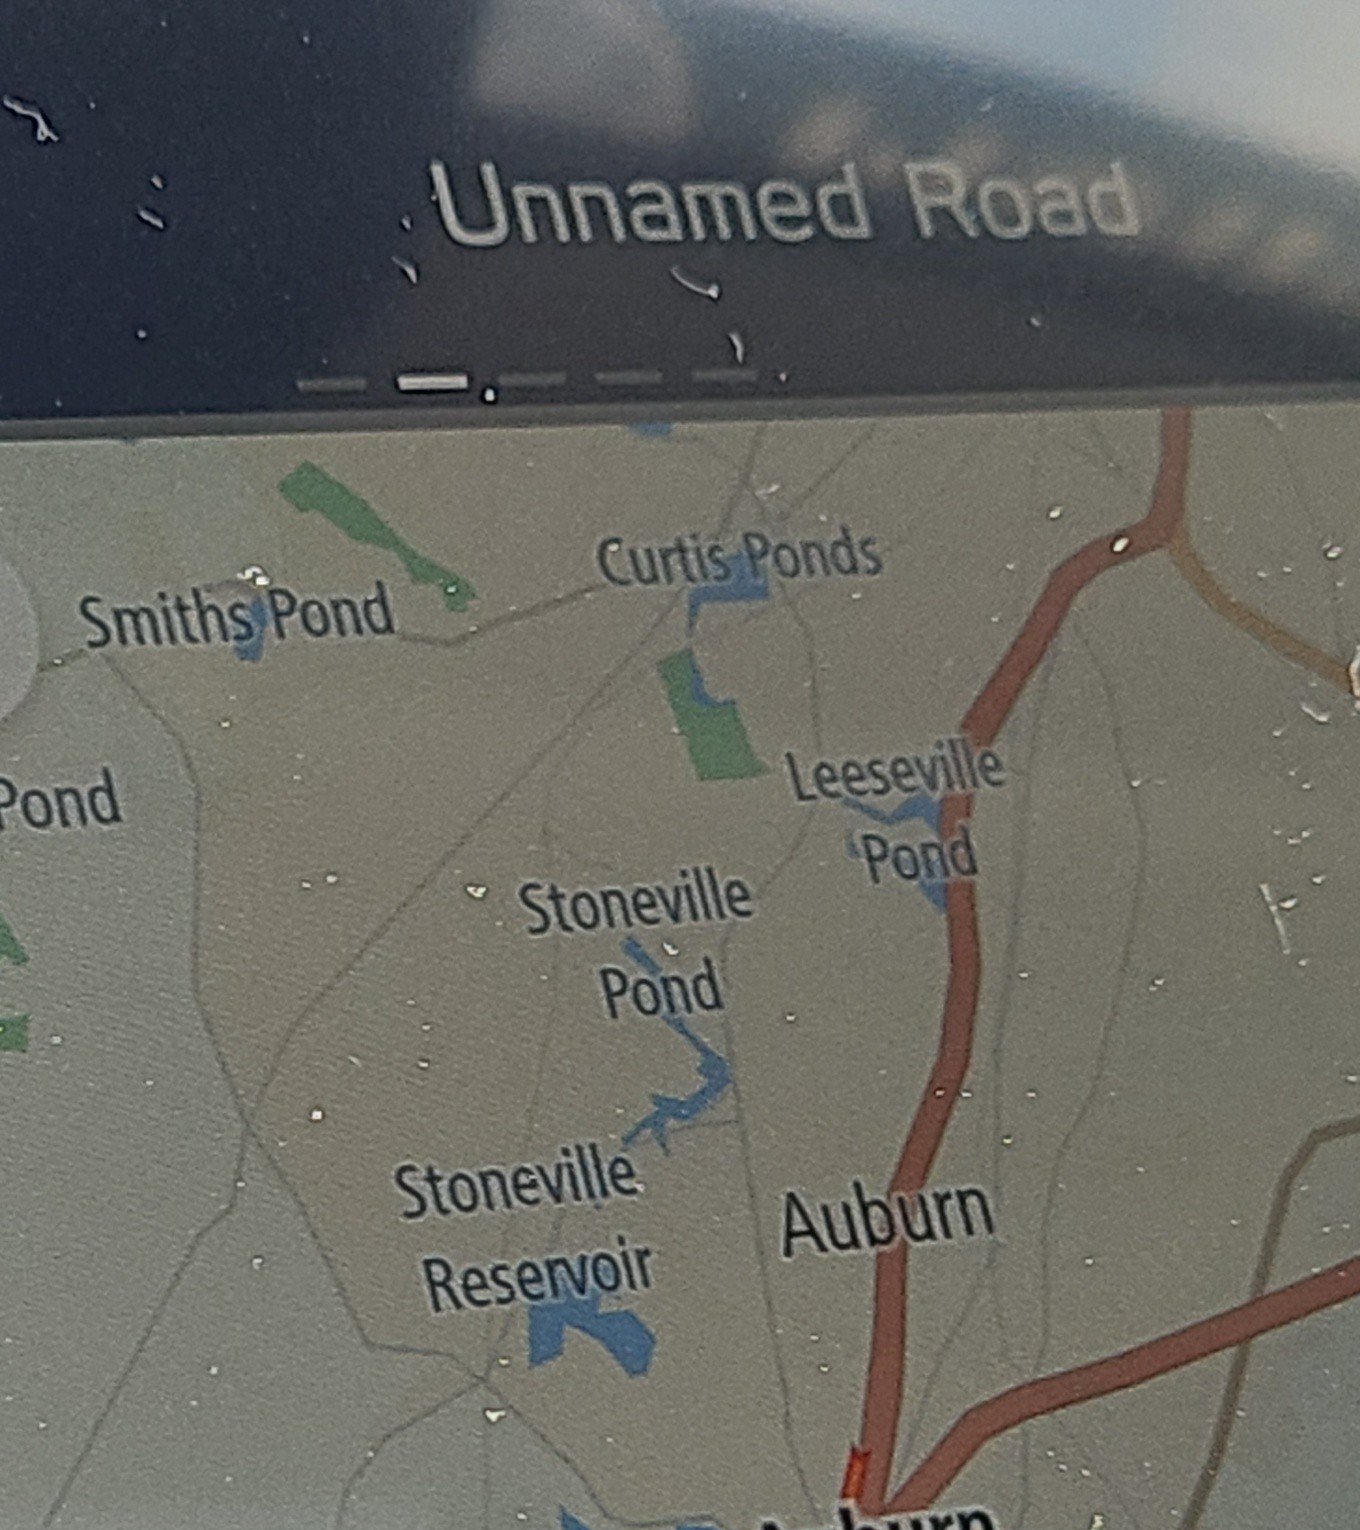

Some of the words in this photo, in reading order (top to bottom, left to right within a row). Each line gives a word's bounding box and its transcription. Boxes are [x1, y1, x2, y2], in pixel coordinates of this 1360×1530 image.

[430, 160, 872, 248] Unnamed
[902, 160, 1139, 239] Road
[596, 535, 731, 589] Curtis
[743, 525, 884, 583] Ponds
[80, 593, 256, 652] Smiths
[268, 580, 396, 640] Pond
[785, 737, 1007, 802] Leeseville
[860, 828, 981, 884] Pond
[518, 864, 755, 937] Stoneville
[599, 957, 725, 1020] Pond
[394, 1143, 640, 1221] Stoneville
[781, 1182, 997, 1259] Auburn
[422, 1234, 653, 1313] Reservoir
